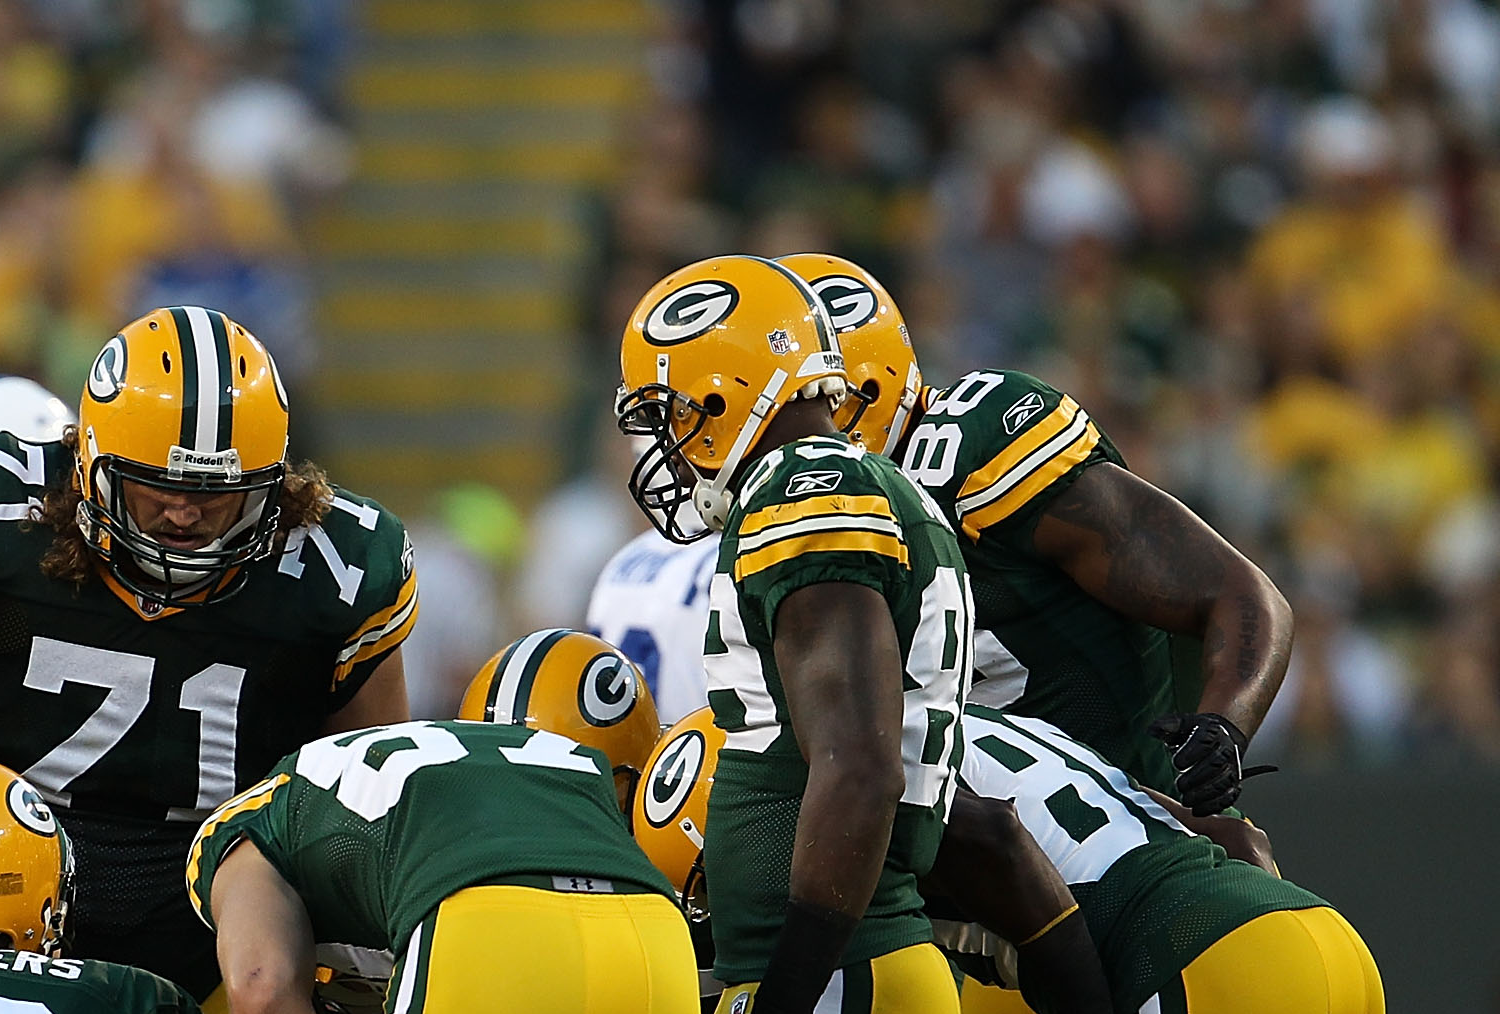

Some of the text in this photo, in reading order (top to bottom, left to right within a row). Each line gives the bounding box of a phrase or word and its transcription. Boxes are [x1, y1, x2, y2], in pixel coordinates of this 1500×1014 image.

[647, 282, 735, 342] G
[811, 276, 875, 328] G
[773, 340, 789, 352] NFL
[904, 370, 1005, 487] 88
[185, 454, 223, 466] Riddell
[584, 656, 637, 721] G
[897, 566, 979, 824] 8
[23, 636, 247, 823] 71
[10, 778, 57, 834] G
[646, 733, 701, 822] G
